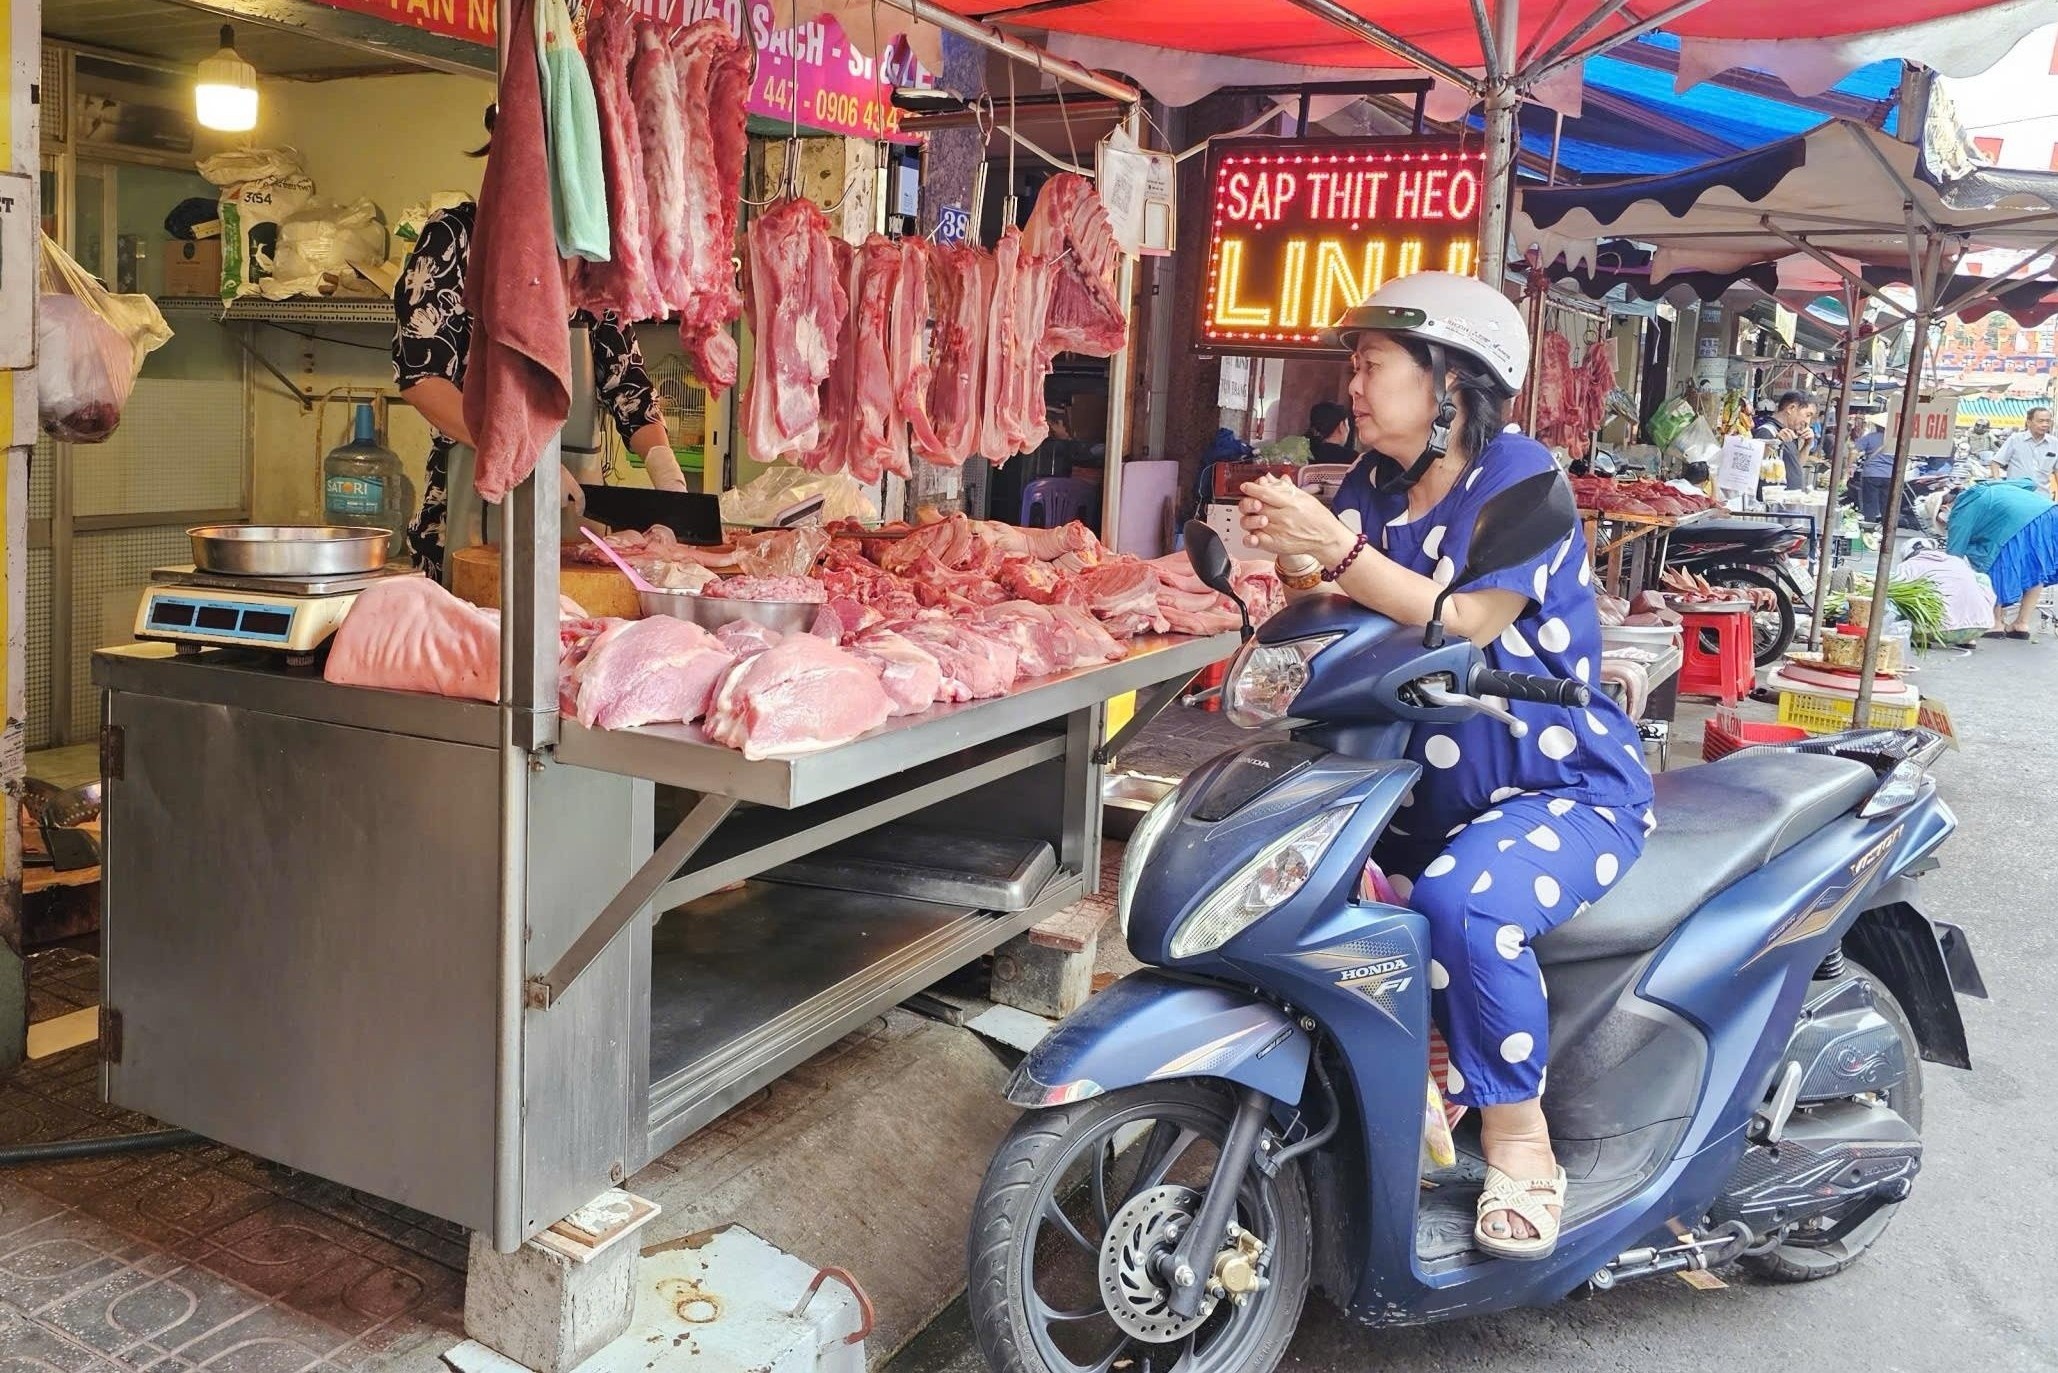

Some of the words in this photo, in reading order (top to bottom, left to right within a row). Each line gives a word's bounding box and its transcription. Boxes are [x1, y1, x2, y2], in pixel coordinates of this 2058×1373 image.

[763, 75, 799, 113] 447
[815, 88, 859, 128] 0906
[1227, 171, 1297, 231] SẠP
[1306, 171, 1389, 231] THỊT
[1395, 169, 1477, 220] HEO
[327, 479, 369, 496] SATORI
[1340, 958, 1409, 981] HONDA
